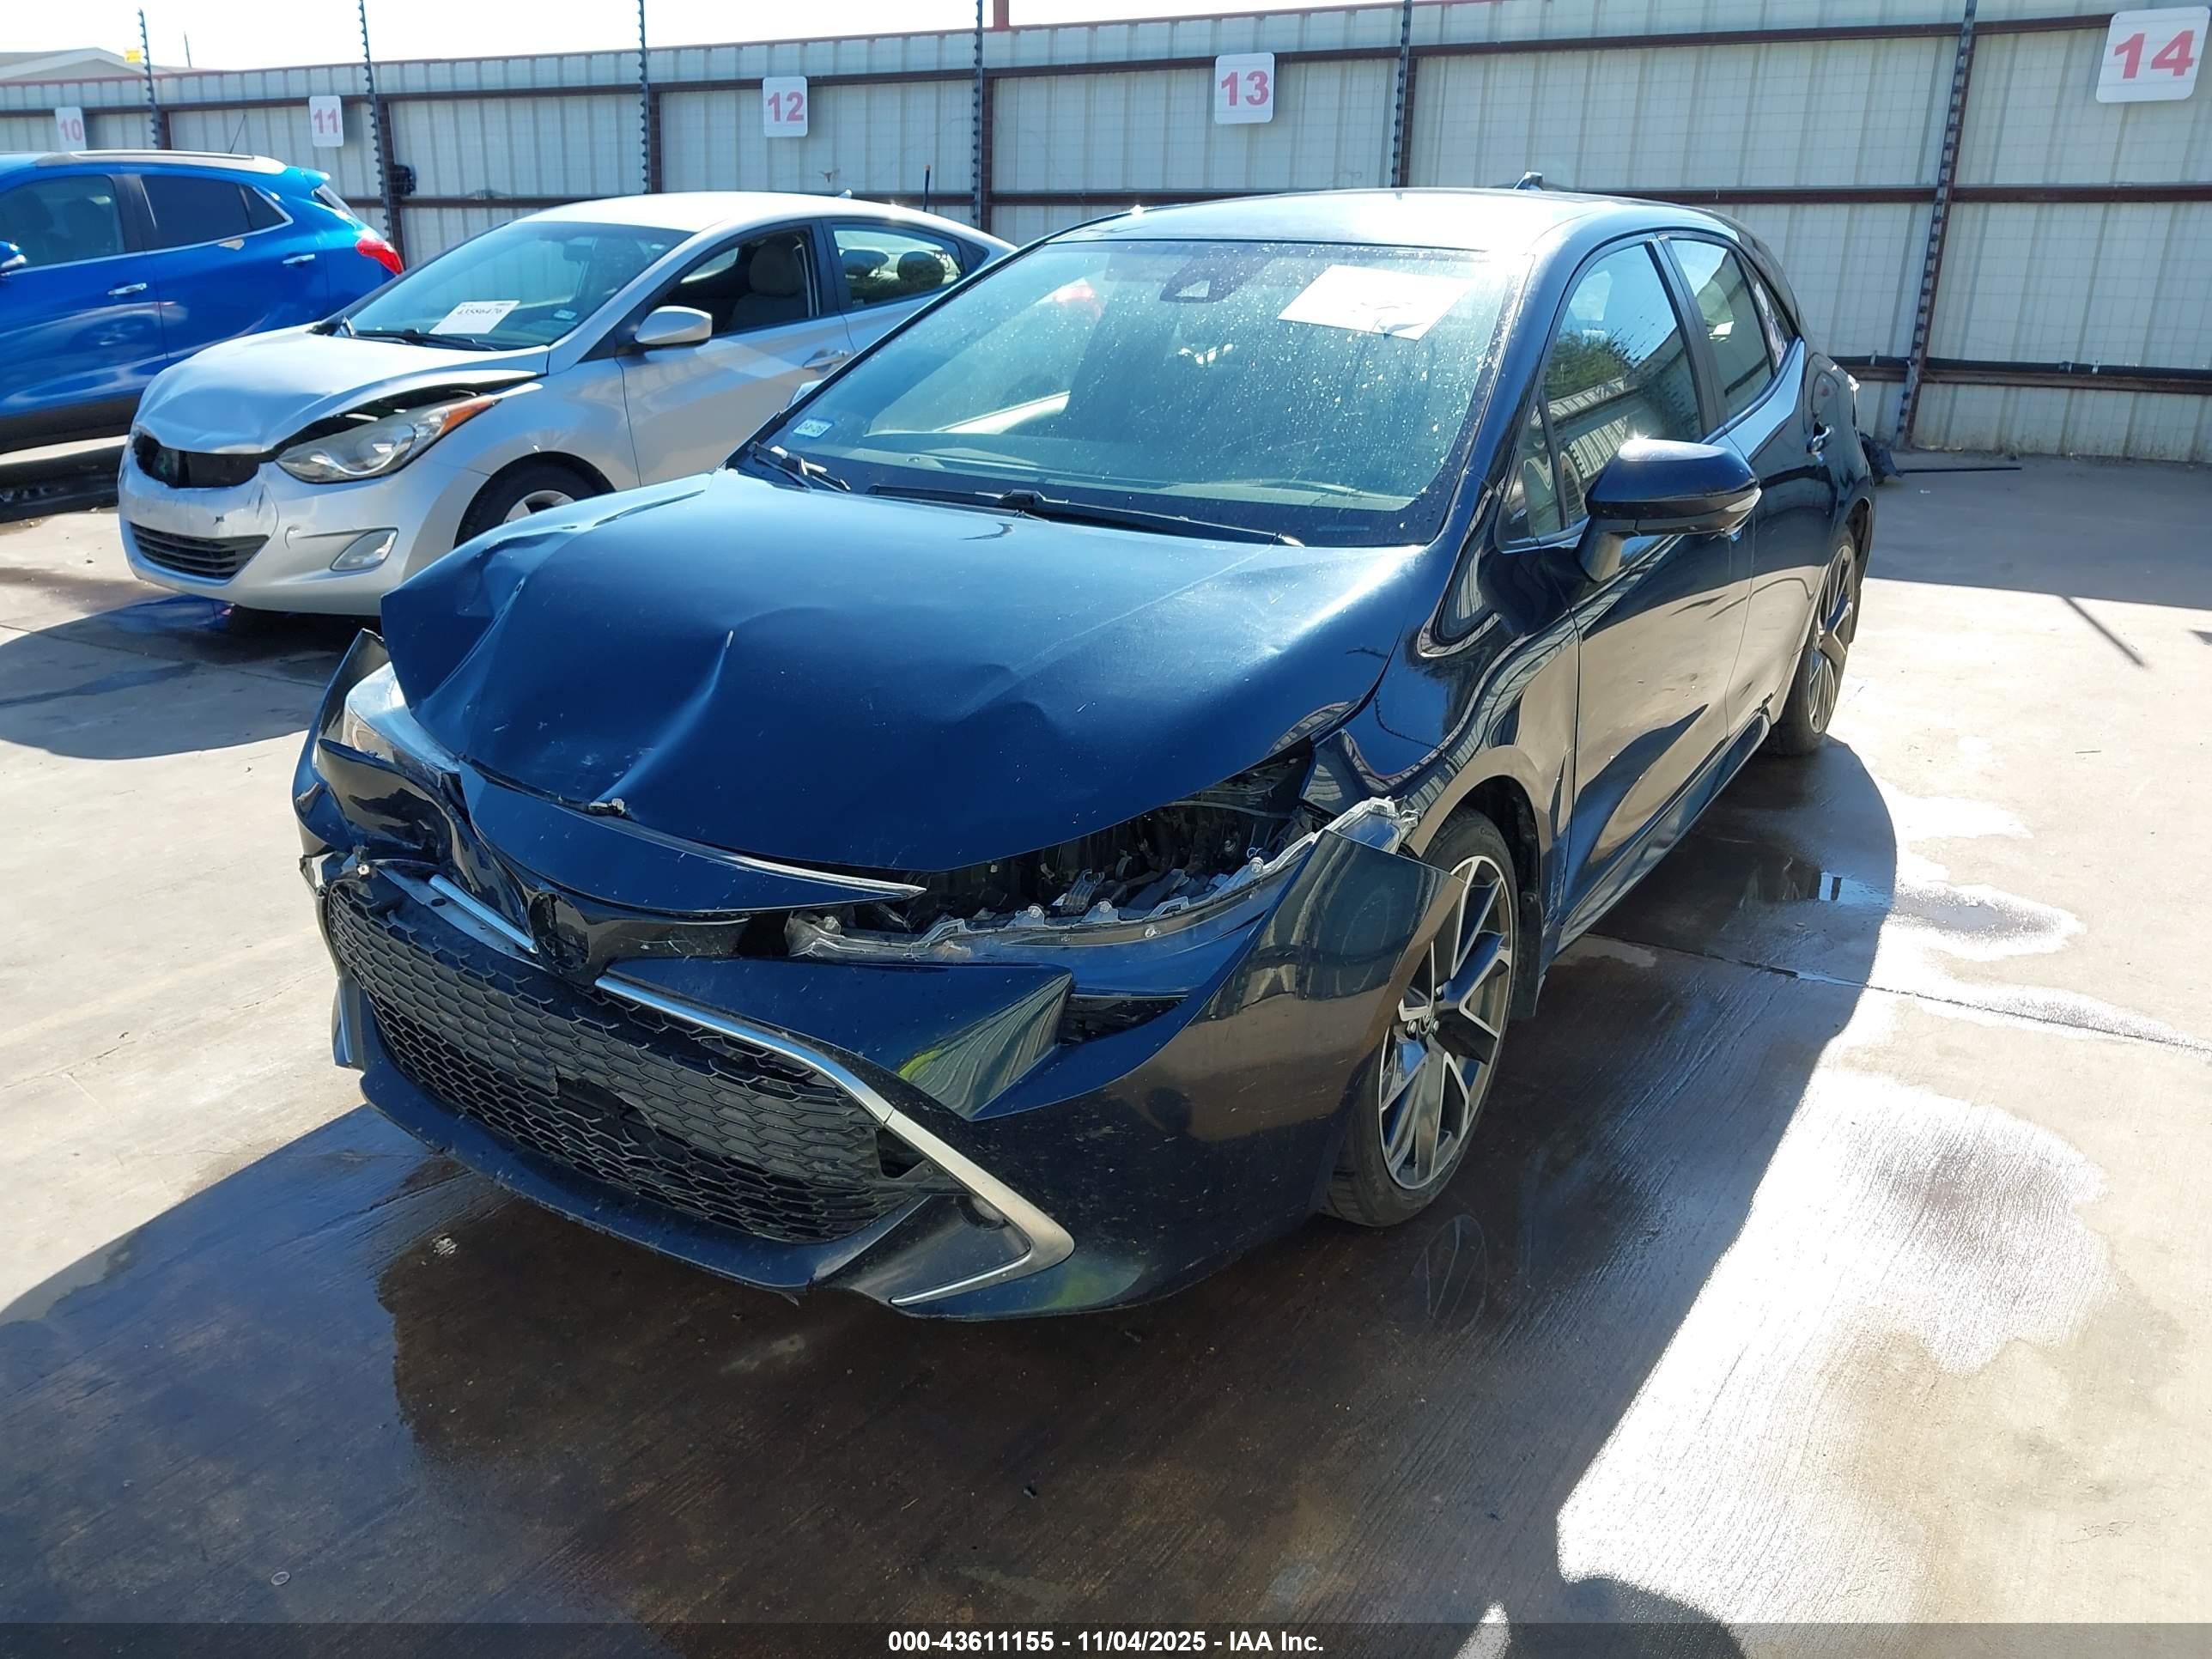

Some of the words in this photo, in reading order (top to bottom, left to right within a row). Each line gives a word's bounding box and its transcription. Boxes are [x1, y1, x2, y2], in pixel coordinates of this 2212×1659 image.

[2114, 29, 2195, 79] 14
[1221, 70, 1269, 106] 13
[314, 108, 338, 134] 11
[768, 91, 805, 122] 12
[60, 118, 83, 142] 10
